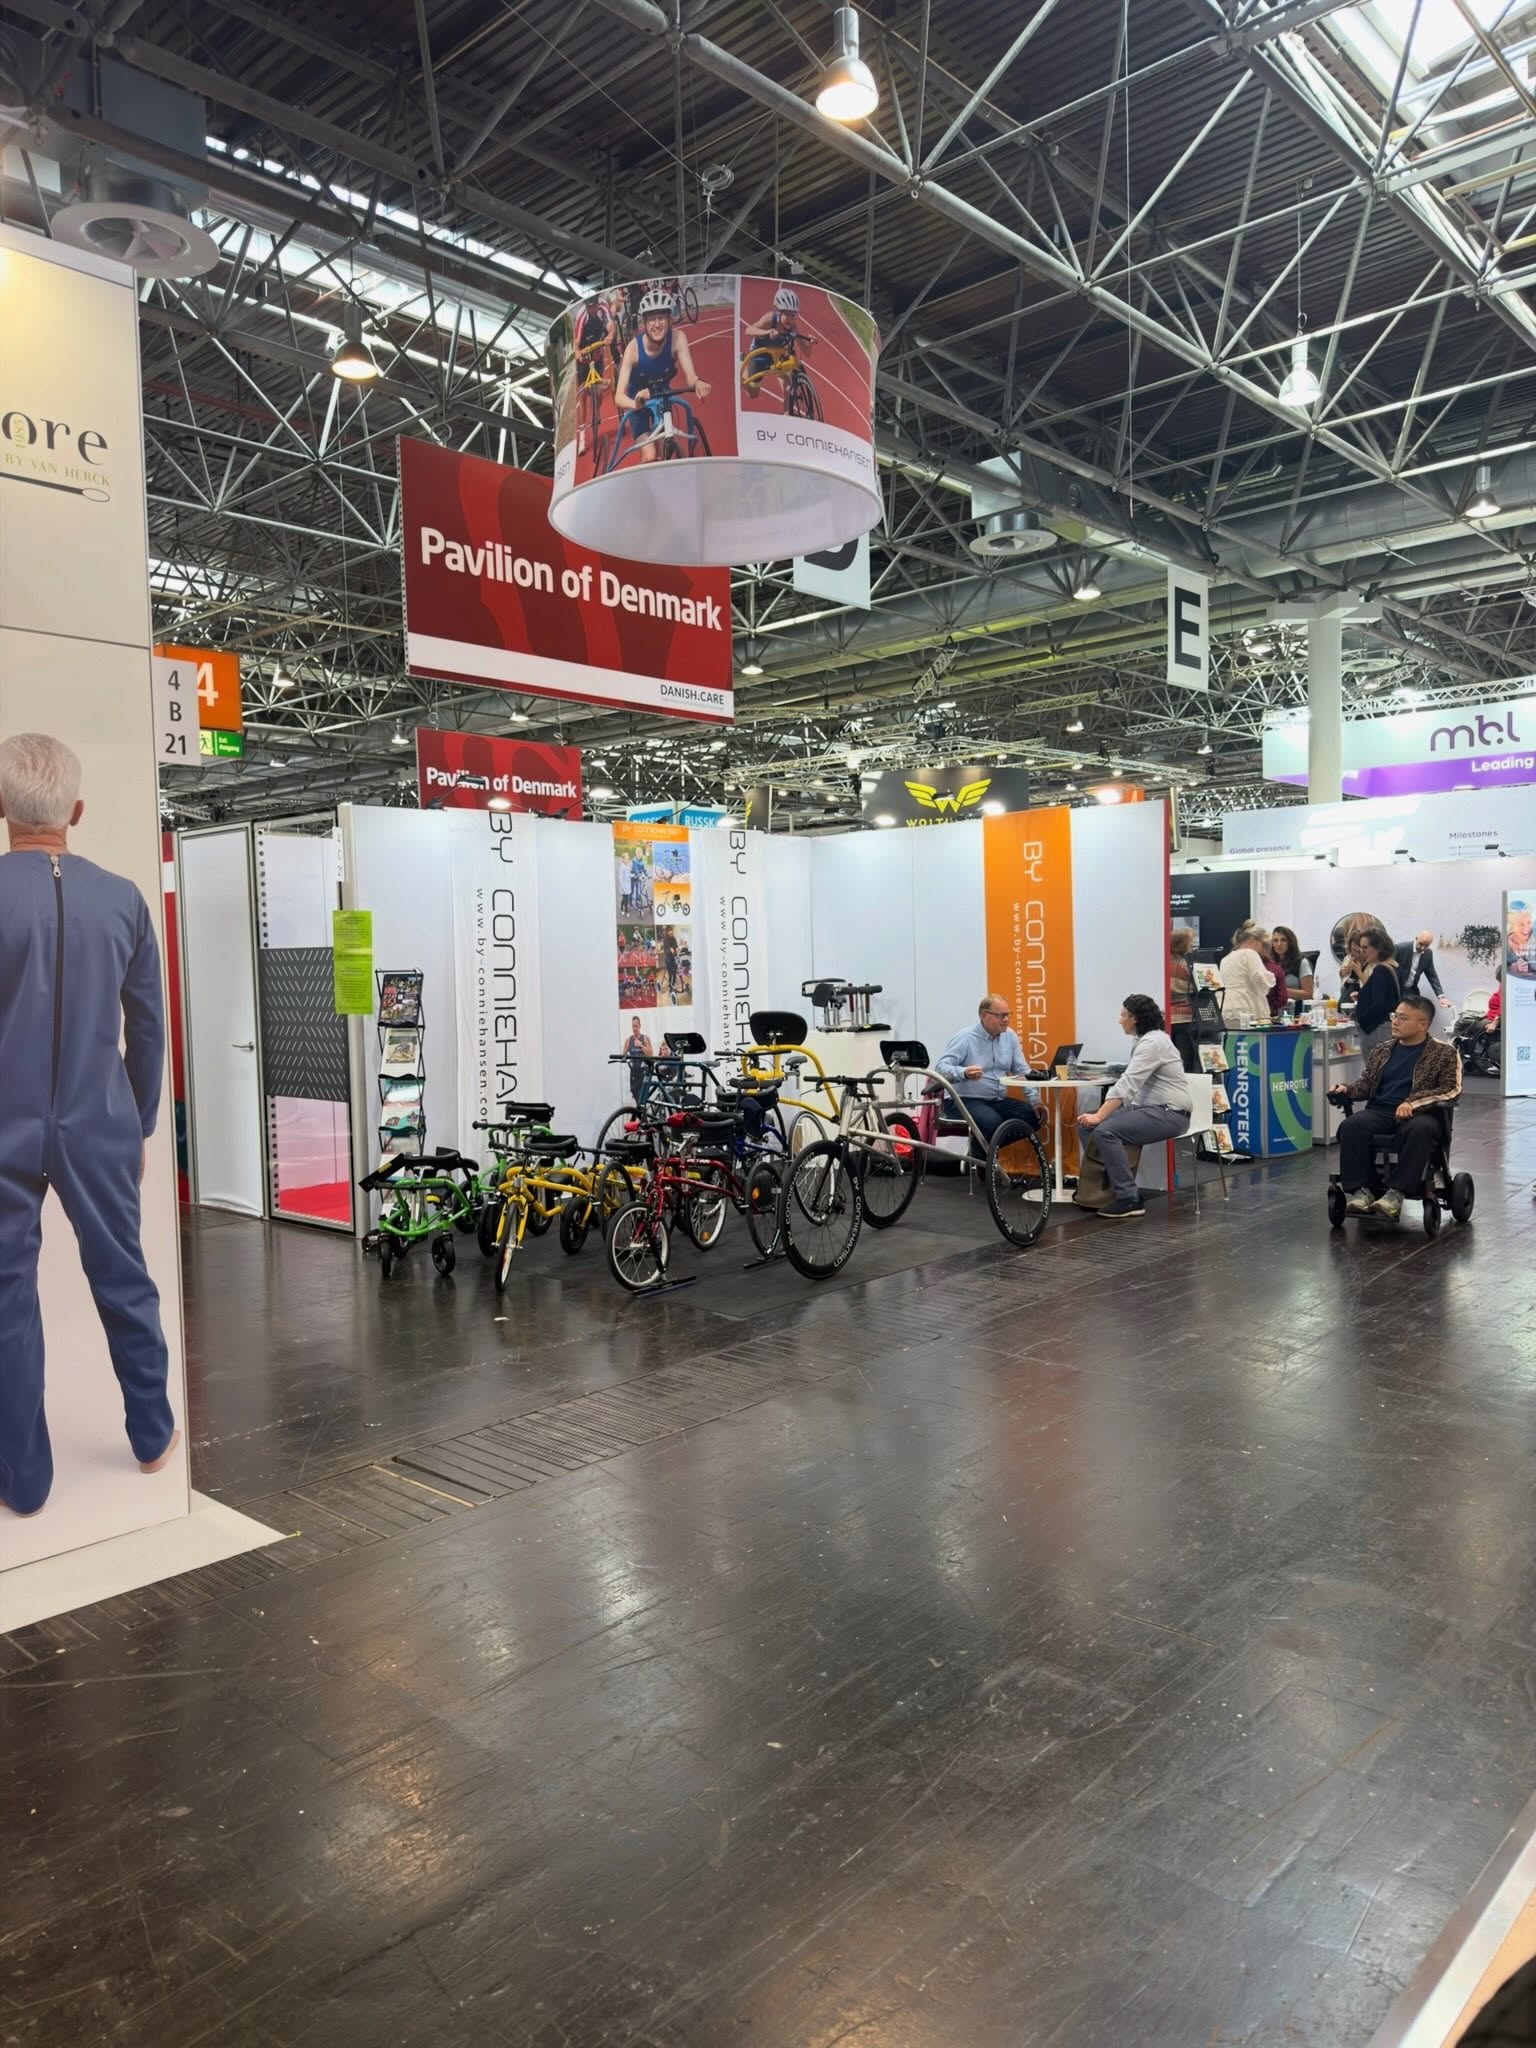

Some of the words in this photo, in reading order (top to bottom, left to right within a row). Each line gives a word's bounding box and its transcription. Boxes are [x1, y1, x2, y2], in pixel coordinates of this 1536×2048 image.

[2, 411, 108, 466] ore
[757, 430, 777, 441] BY
[786, 433, 872, 470] CONNIEHANSEN
[5, 453, 22, 467] BY
[31, 458, 57, 473] VAN
[65, 466, 110, 486] HERCK
[421, 526, 554, 593] Pavilion
[561, 565, 593, 602] of
[600, 570, 723, 632] Denmark
[1175, 586, 1201, 671] E
[167, 670, 180, 691] 4
[197, 662, 219, 707] 4
[660, 684, 725, 705] DANISH.CARE
[169, 701, 182, 722] B
[165, 733, 186, 756] 21
[1471, 756, 1535, 773] Leading
[493, 774, 510, 791] of
[512, 777, 577, 799] Denmark
[489, 811, 513, 863] BY
[729, 830, 747, 875] BY
[1449, 830, 1498, 840] Milestones
[1023, 841, 1042, 882] BY
[492, 889, 517, 1105] CONNIEHA
[1025, 900, 1048, 1071] CONNIEHA
[1233, 1041, 1249, 1144] HENROTEK
[1272, 1078, 1309, 1093] HENROTEK
